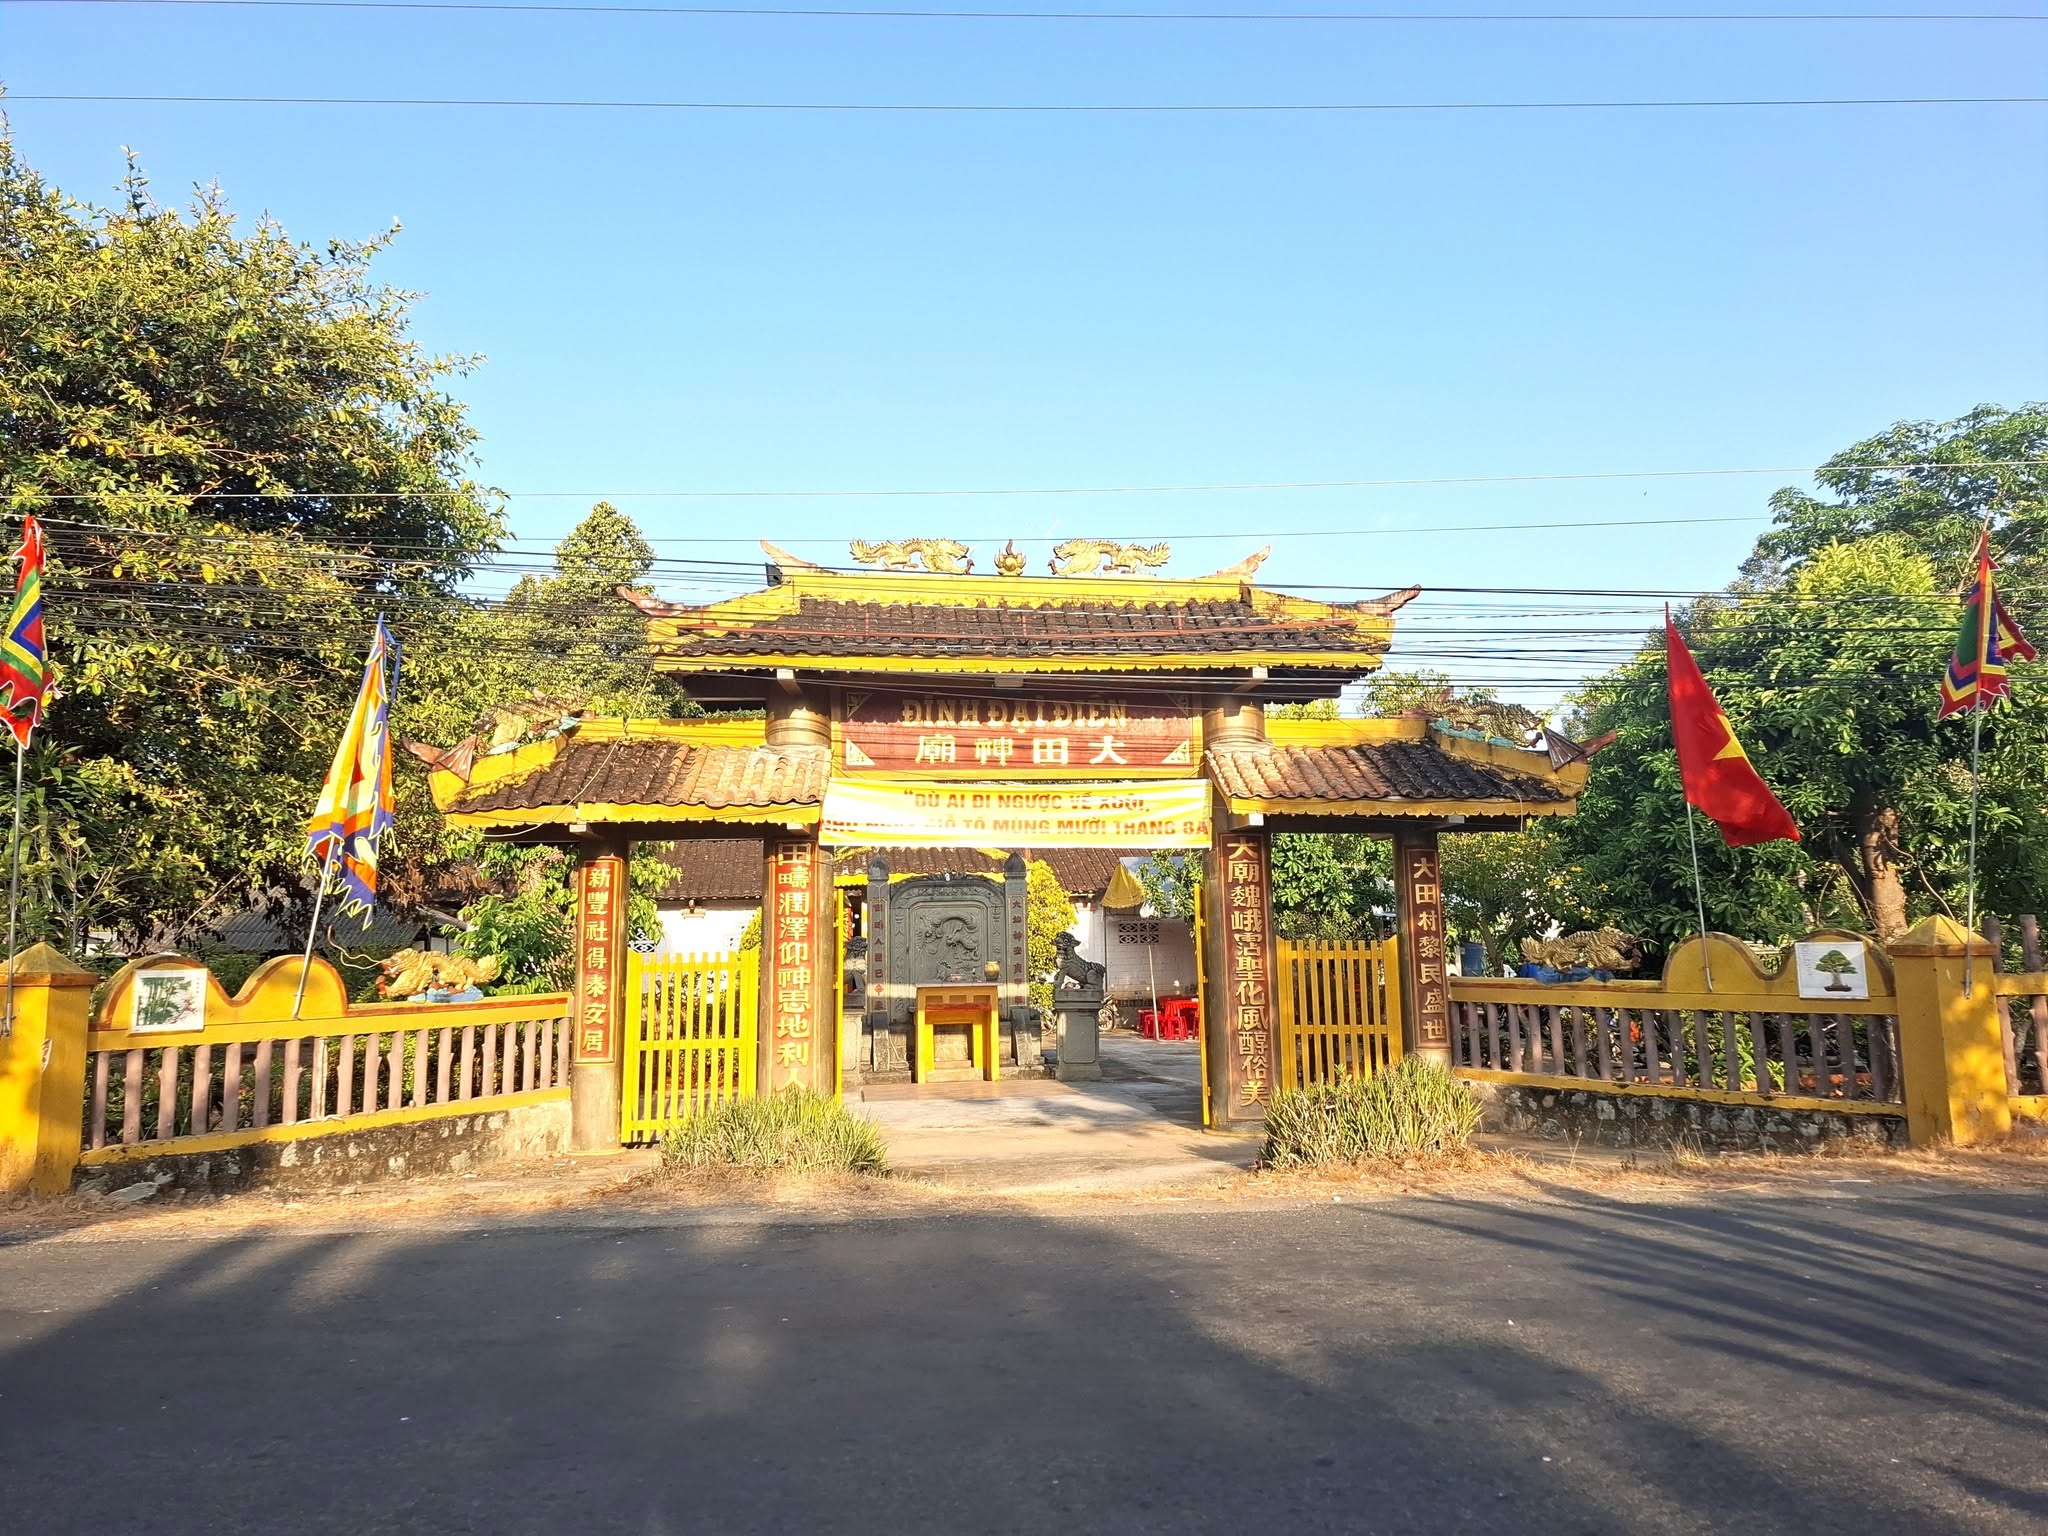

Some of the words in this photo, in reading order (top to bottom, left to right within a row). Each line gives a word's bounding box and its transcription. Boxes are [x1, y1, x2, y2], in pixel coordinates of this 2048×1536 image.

[947, 793, 966, 808] AI
[1057, 816, 1106, 835] MƯỜI
[583, 867, 612, 1053] 新豐社得泰安居
[1412, 857, 1446, 1040] 大田村黎民盛世
